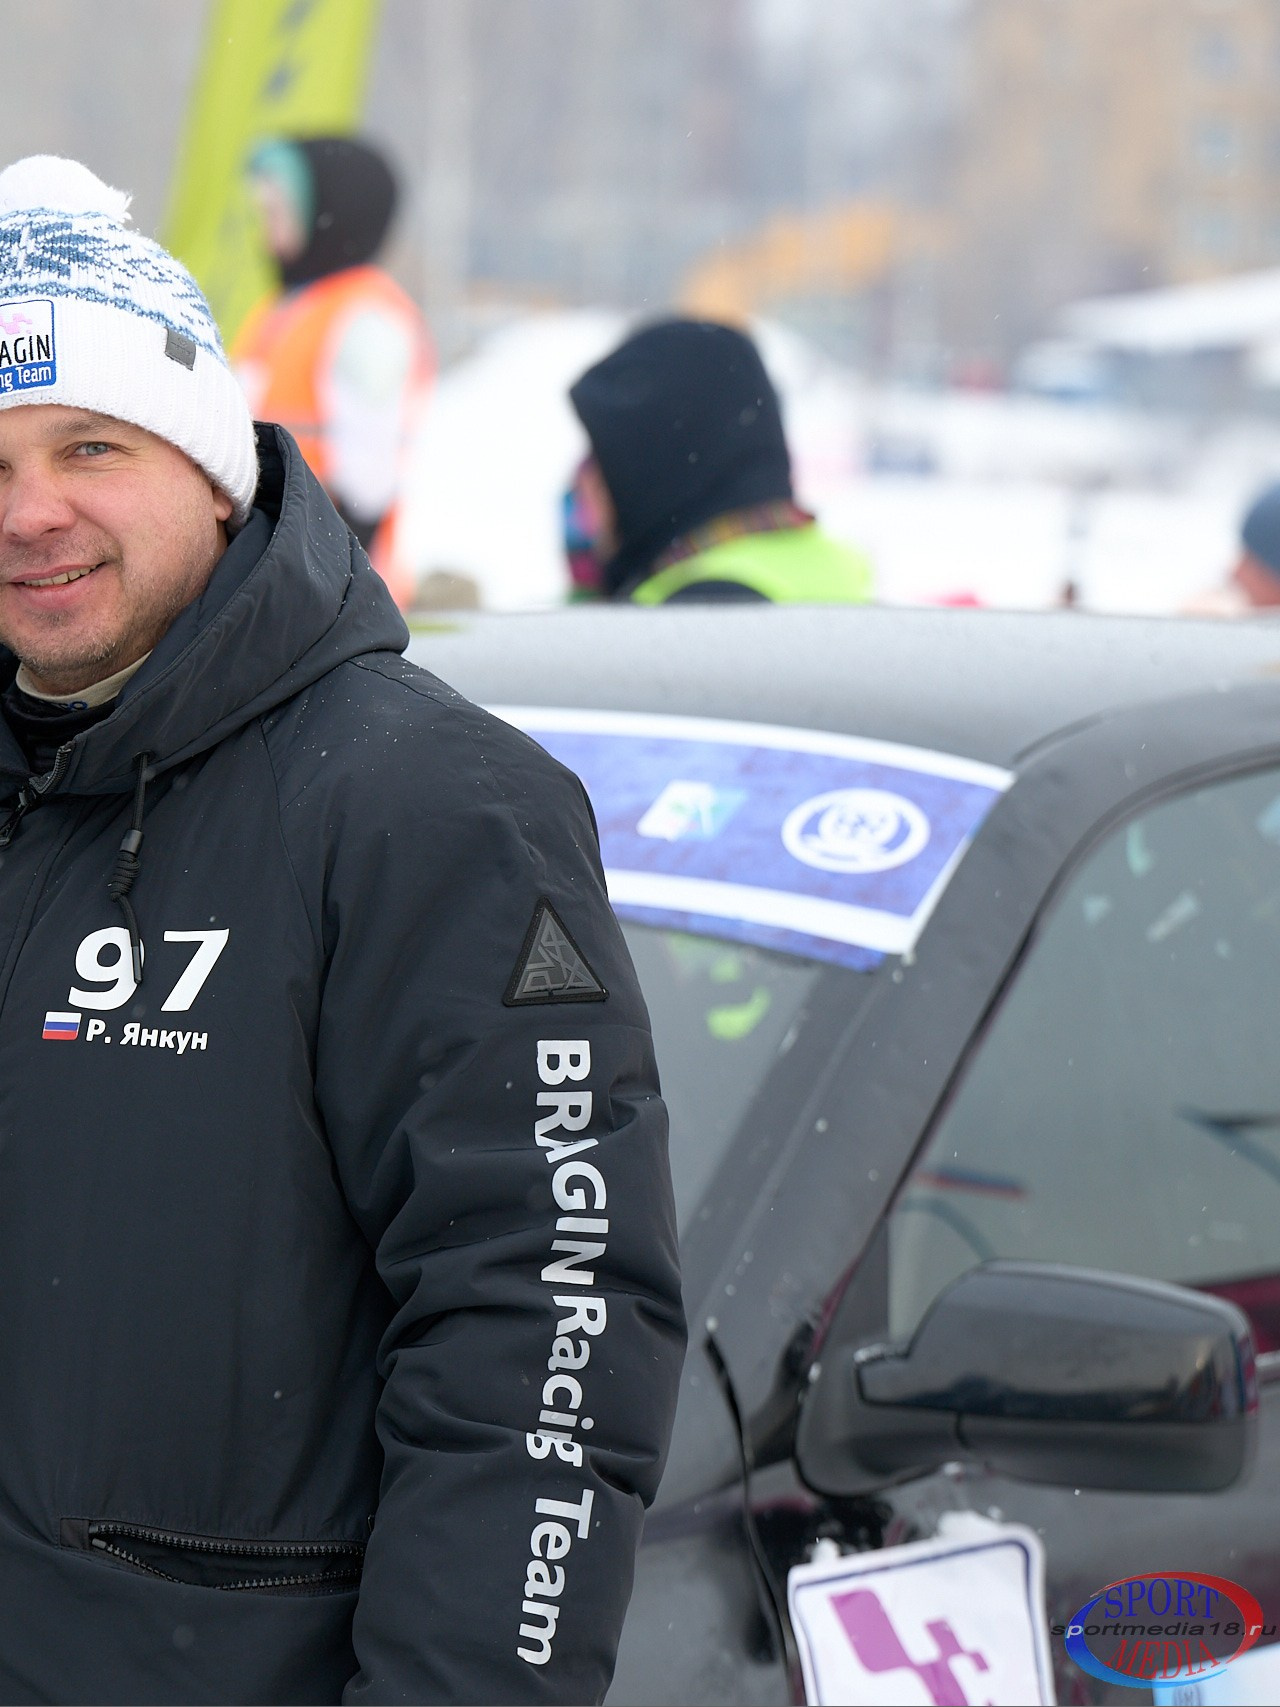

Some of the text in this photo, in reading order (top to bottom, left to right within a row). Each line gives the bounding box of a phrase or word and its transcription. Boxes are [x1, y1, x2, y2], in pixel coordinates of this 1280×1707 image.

[15, 366, 52, 384] Team
[68, 926, 230, 1012] 97
[86, 1018, 208, 1055] Р. Янкун
[534, 1039, 609, 1286] BRAGIN
[516, 1488, 595, 1666] Team
